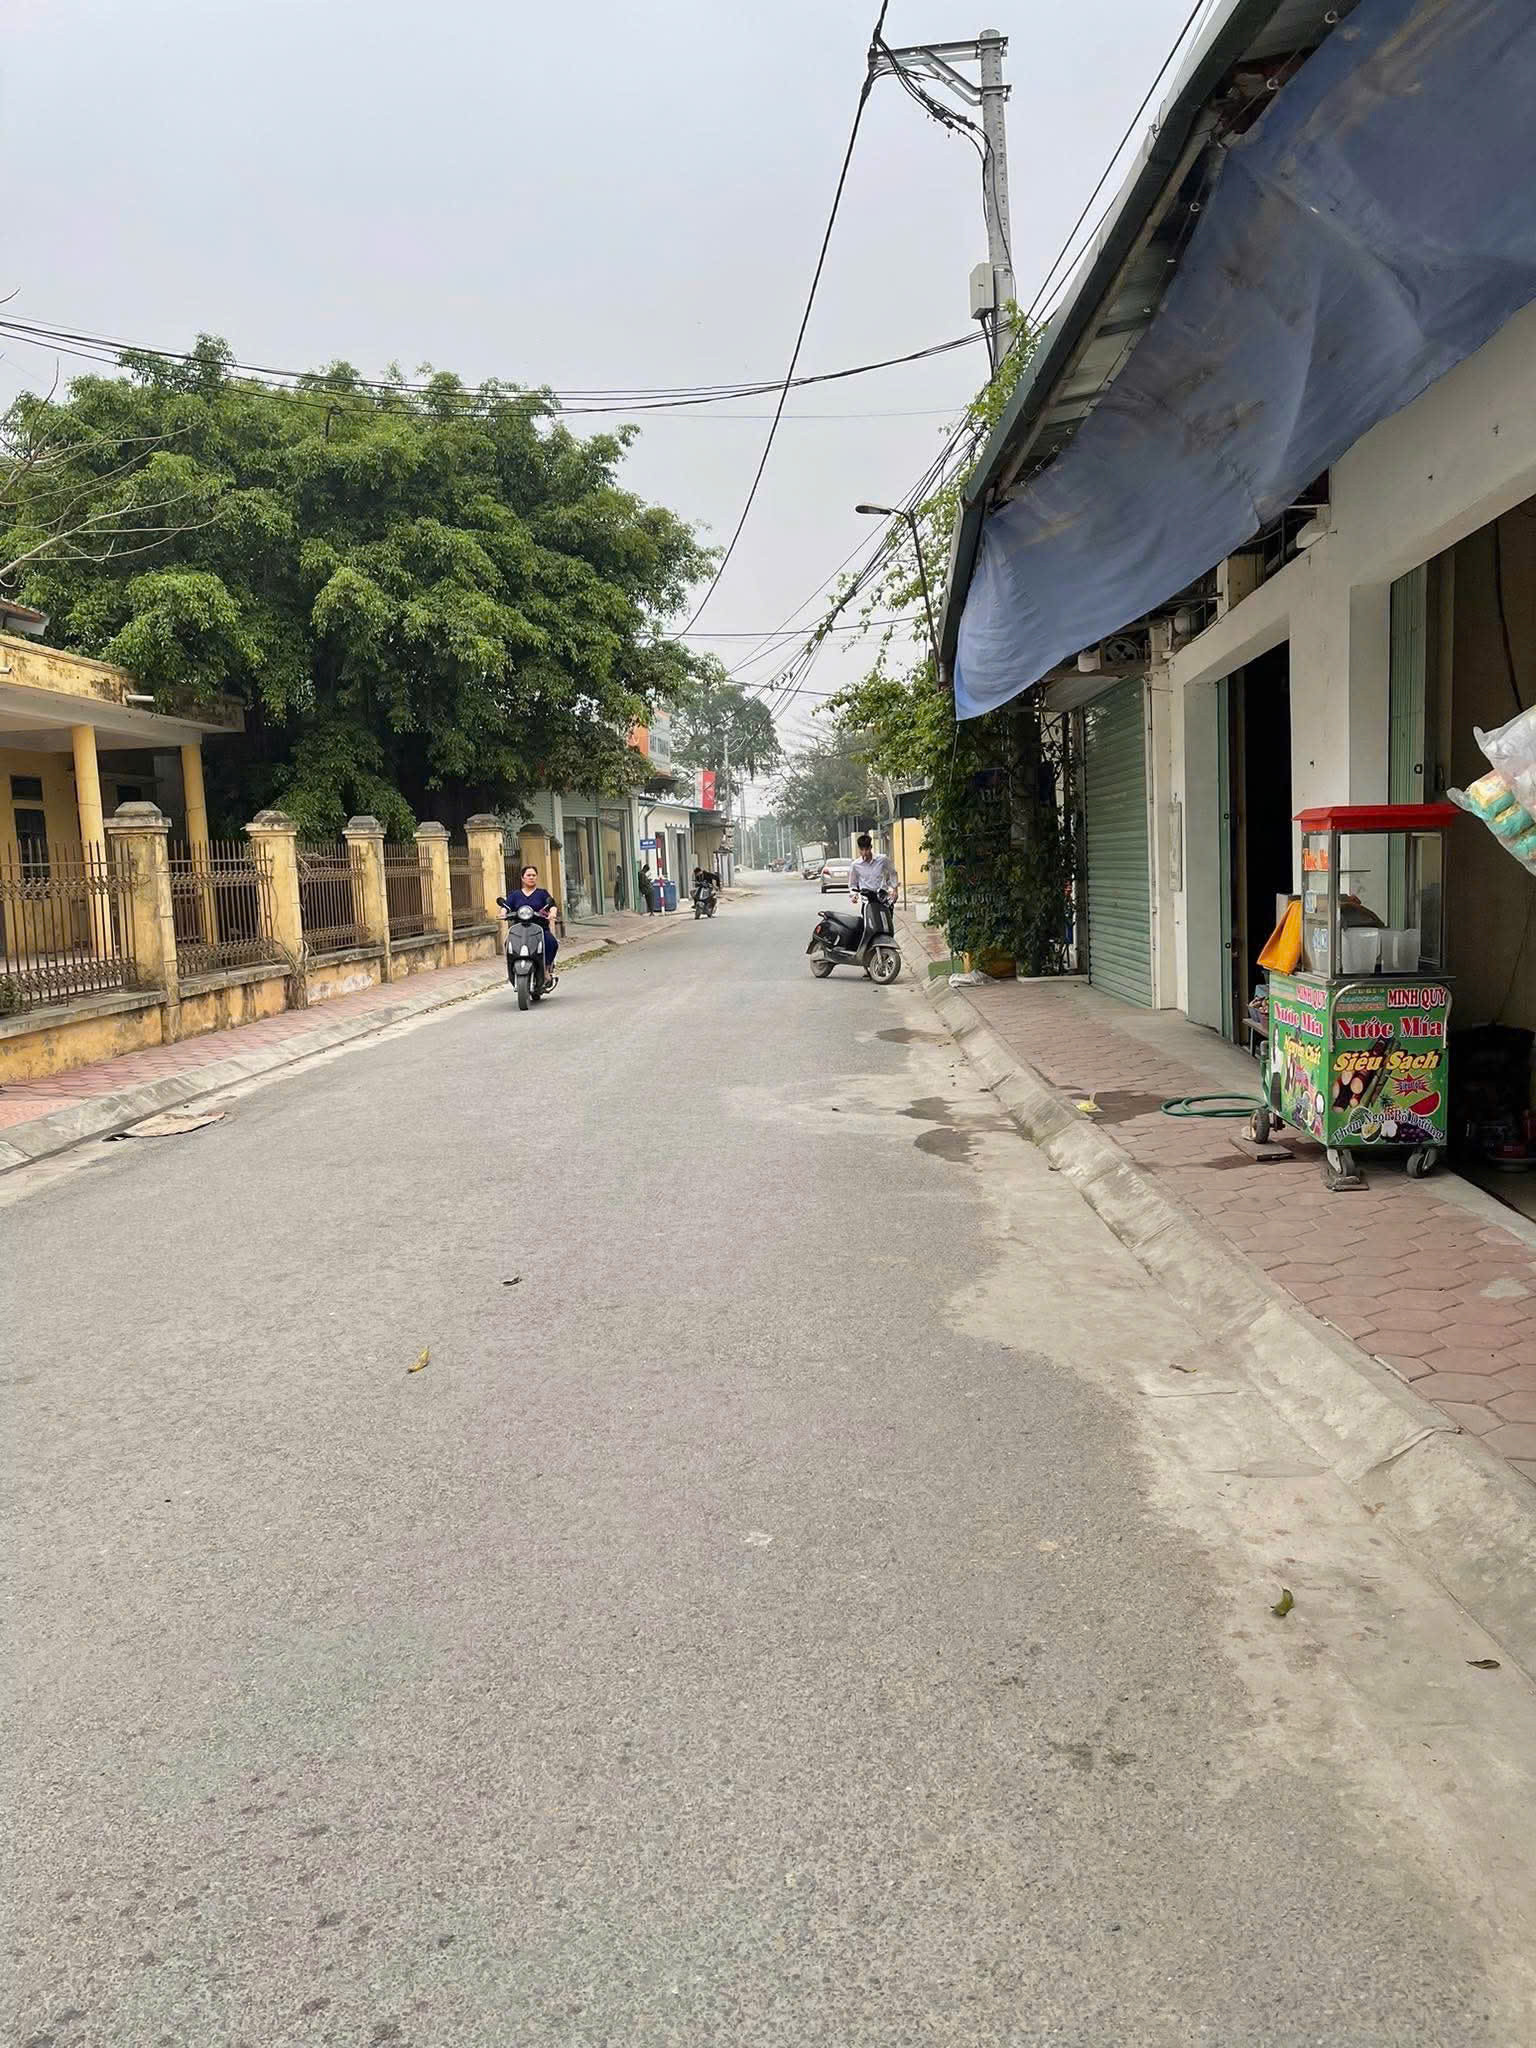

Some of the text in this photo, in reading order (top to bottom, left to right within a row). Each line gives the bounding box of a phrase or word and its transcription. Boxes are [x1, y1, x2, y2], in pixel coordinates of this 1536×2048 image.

[1387, 988, 1420, 1007] MINH
[1301, 1011, 1323, 1037] Mía
[1336, 1016, 1443, 1039] Nước Mía
[1333, 1050, 1440, 1072] Siêu Sạch
